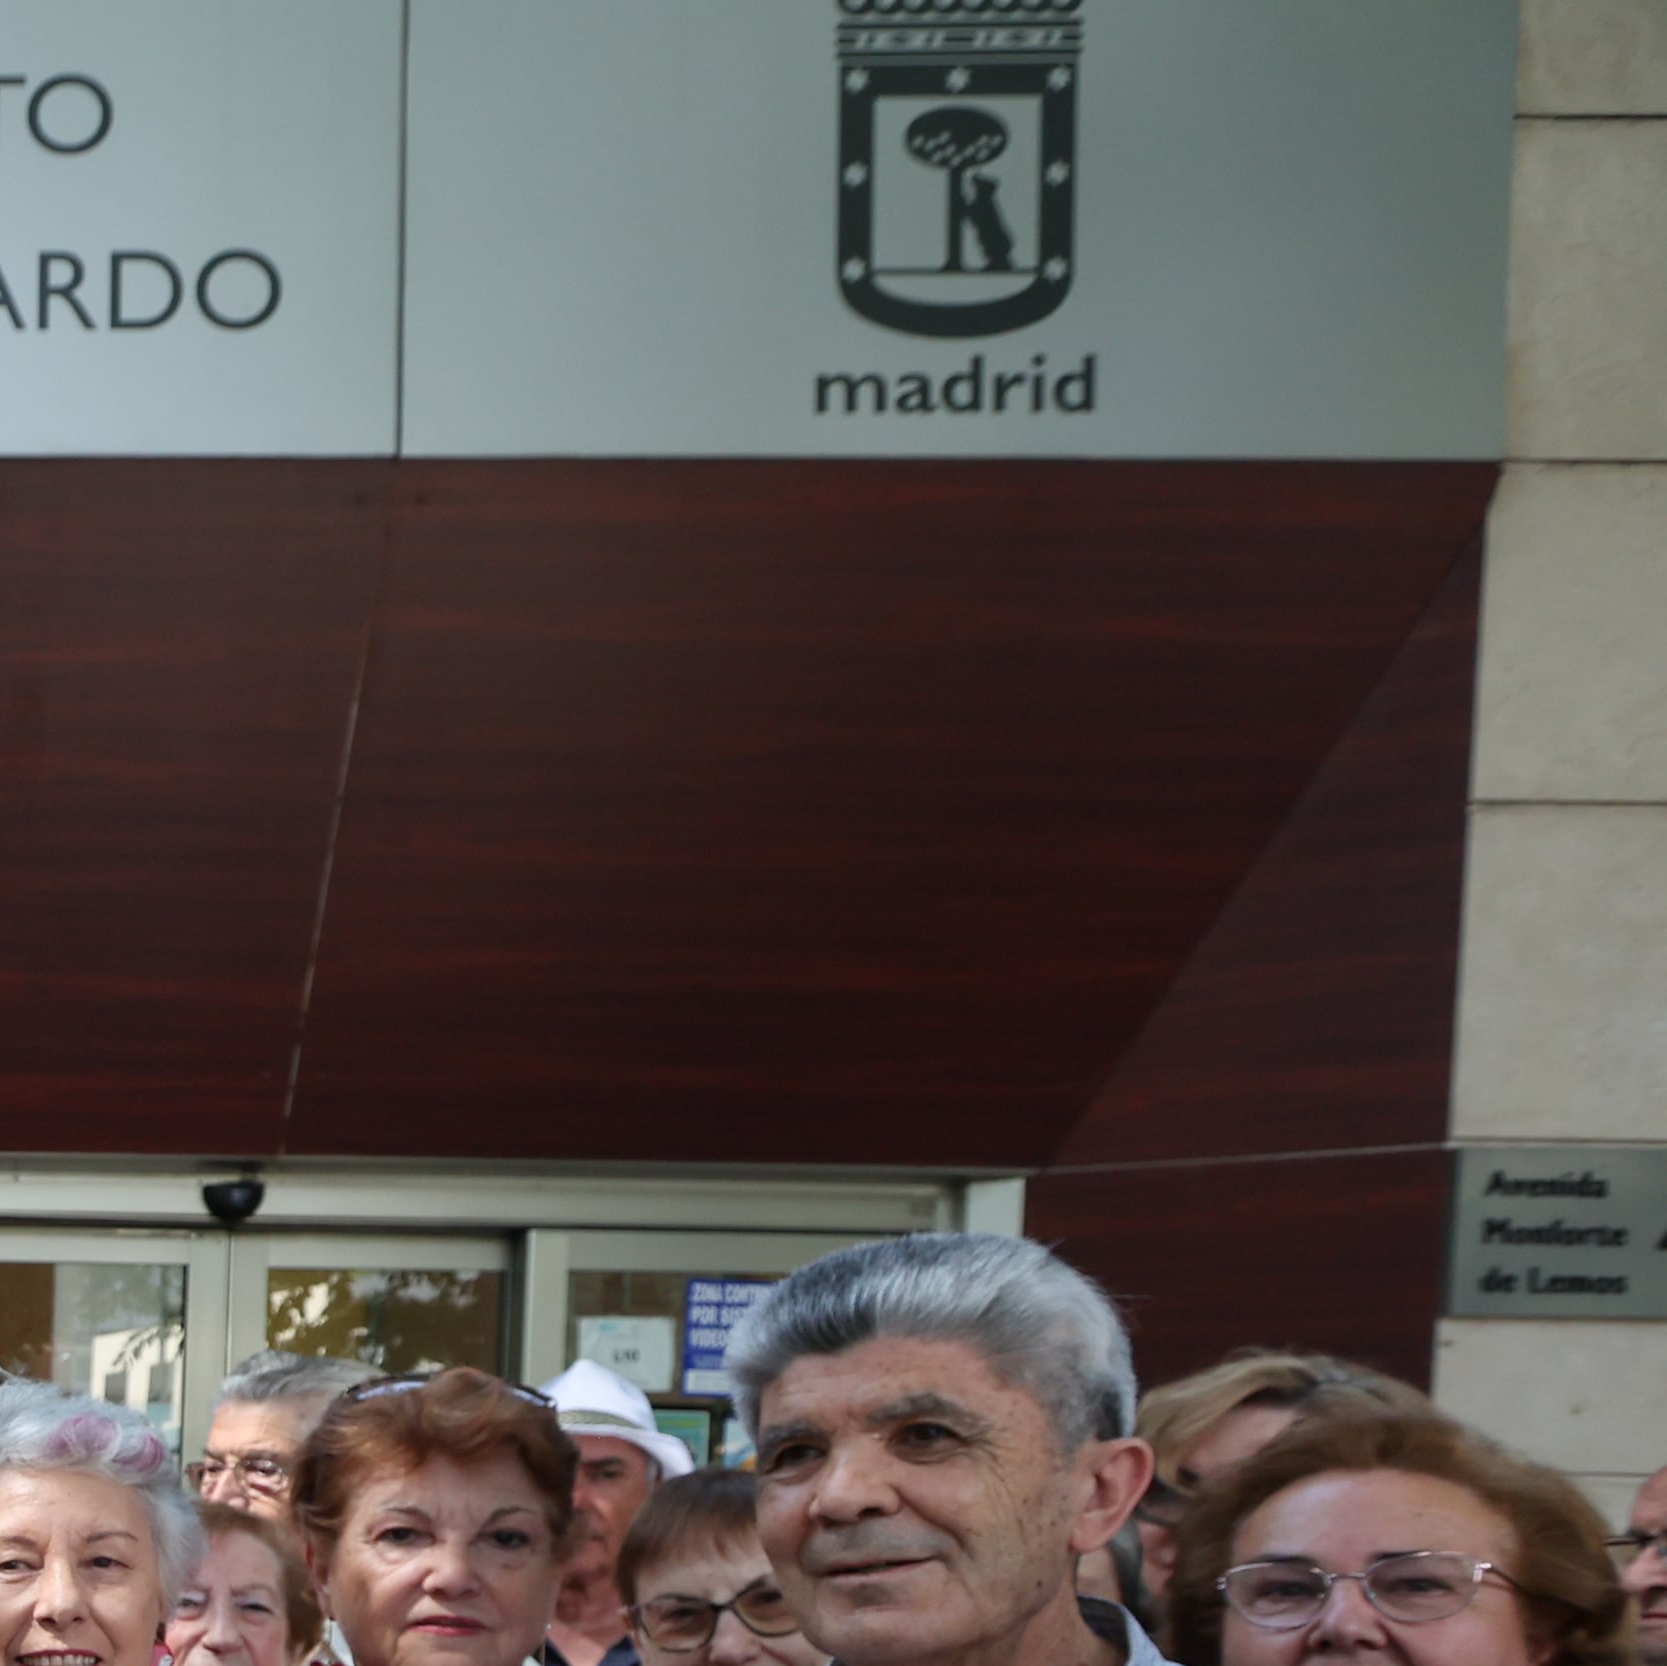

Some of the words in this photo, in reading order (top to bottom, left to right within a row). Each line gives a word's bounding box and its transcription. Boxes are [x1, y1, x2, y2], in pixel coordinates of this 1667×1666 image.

[814, 355, 1097, 414] madrid
[1485, 1169, 1609, 1198] Avenida
[1481, 1217, 1629, 1246] Monforte
[1478, 1265, 1517, 1294] de
[1526, 1265, 1629, 1295] Lemos
